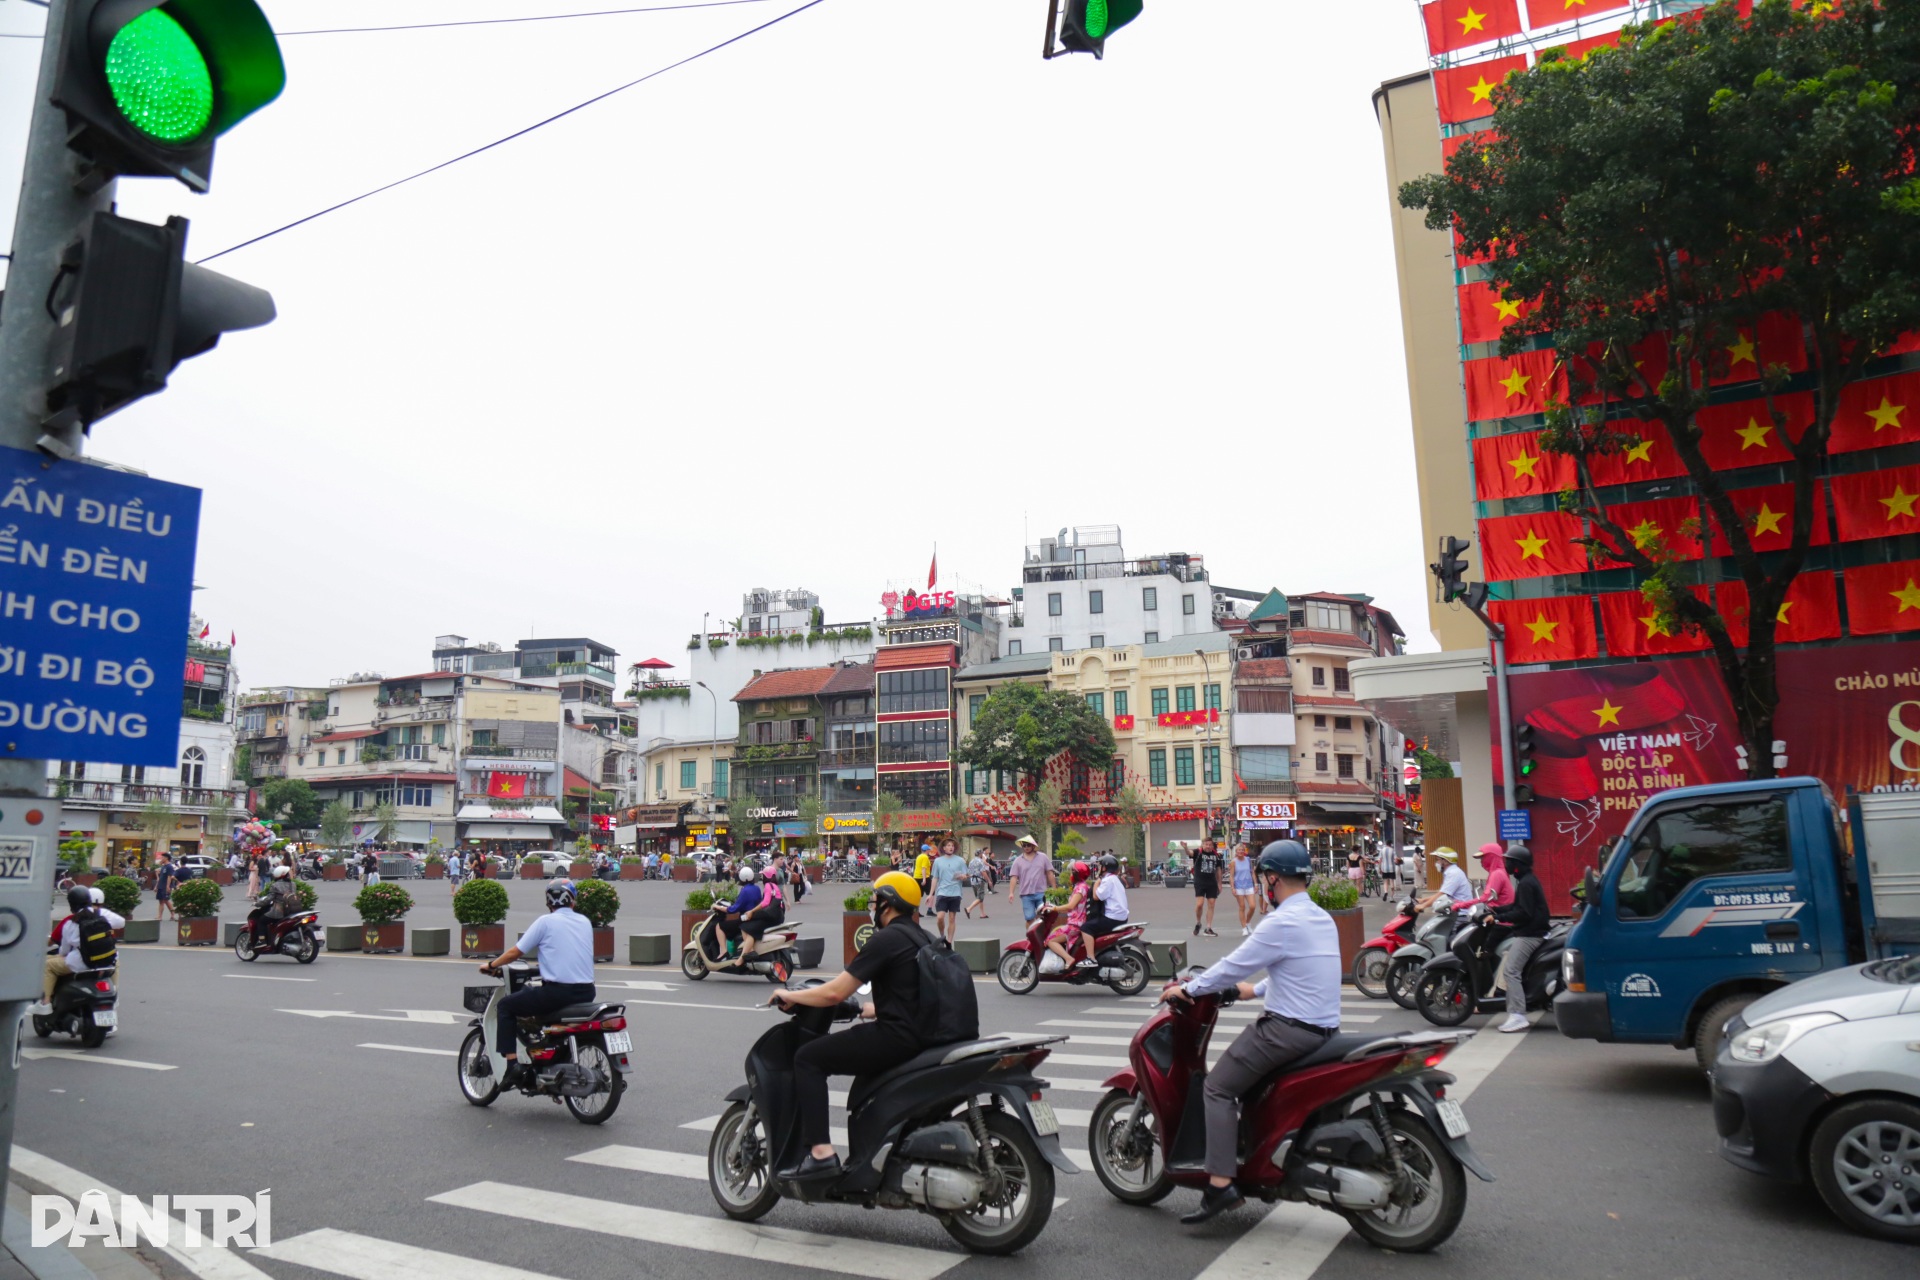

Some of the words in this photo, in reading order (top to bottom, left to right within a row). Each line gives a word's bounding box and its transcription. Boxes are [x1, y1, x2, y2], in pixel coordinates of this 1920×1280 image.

[1, 478, 64, 517] ẤN
[76, 497, 171, 536] ĐIỀU
[62, 546, 147, 584] ĐÈN
[903, 591, 955, 612] DGTS
[50, 599, 140, 633] CHO
[38, 653, 82, 682] ĐI
[95, 657, 154, 696] BỘ
[1835, 671, 1888, 691] CHÀO
[1599, 733, 1637, 754] VIỆT
[1641, 733, 1680, 749] NAM
[1601, 753, 1637, 773] ĐỘC
[1640, 751, 1674, 771] LẬP
[1603, 772, 1639, 791] HOÀ
[1642, 771, 1685, 789] BÌNH
[1241, 804, 1260, 817] FS
[1262, 804, 1292, 817] SPA
[1713, 895, 1729, 905] ĐT:
[1730, 894, 1752, 905] 0975
[1773, 892, 1791, 903] 645
[1751, 943, 1774, 955] NHẸ
[1776, 943, 1795, 953] TAY
